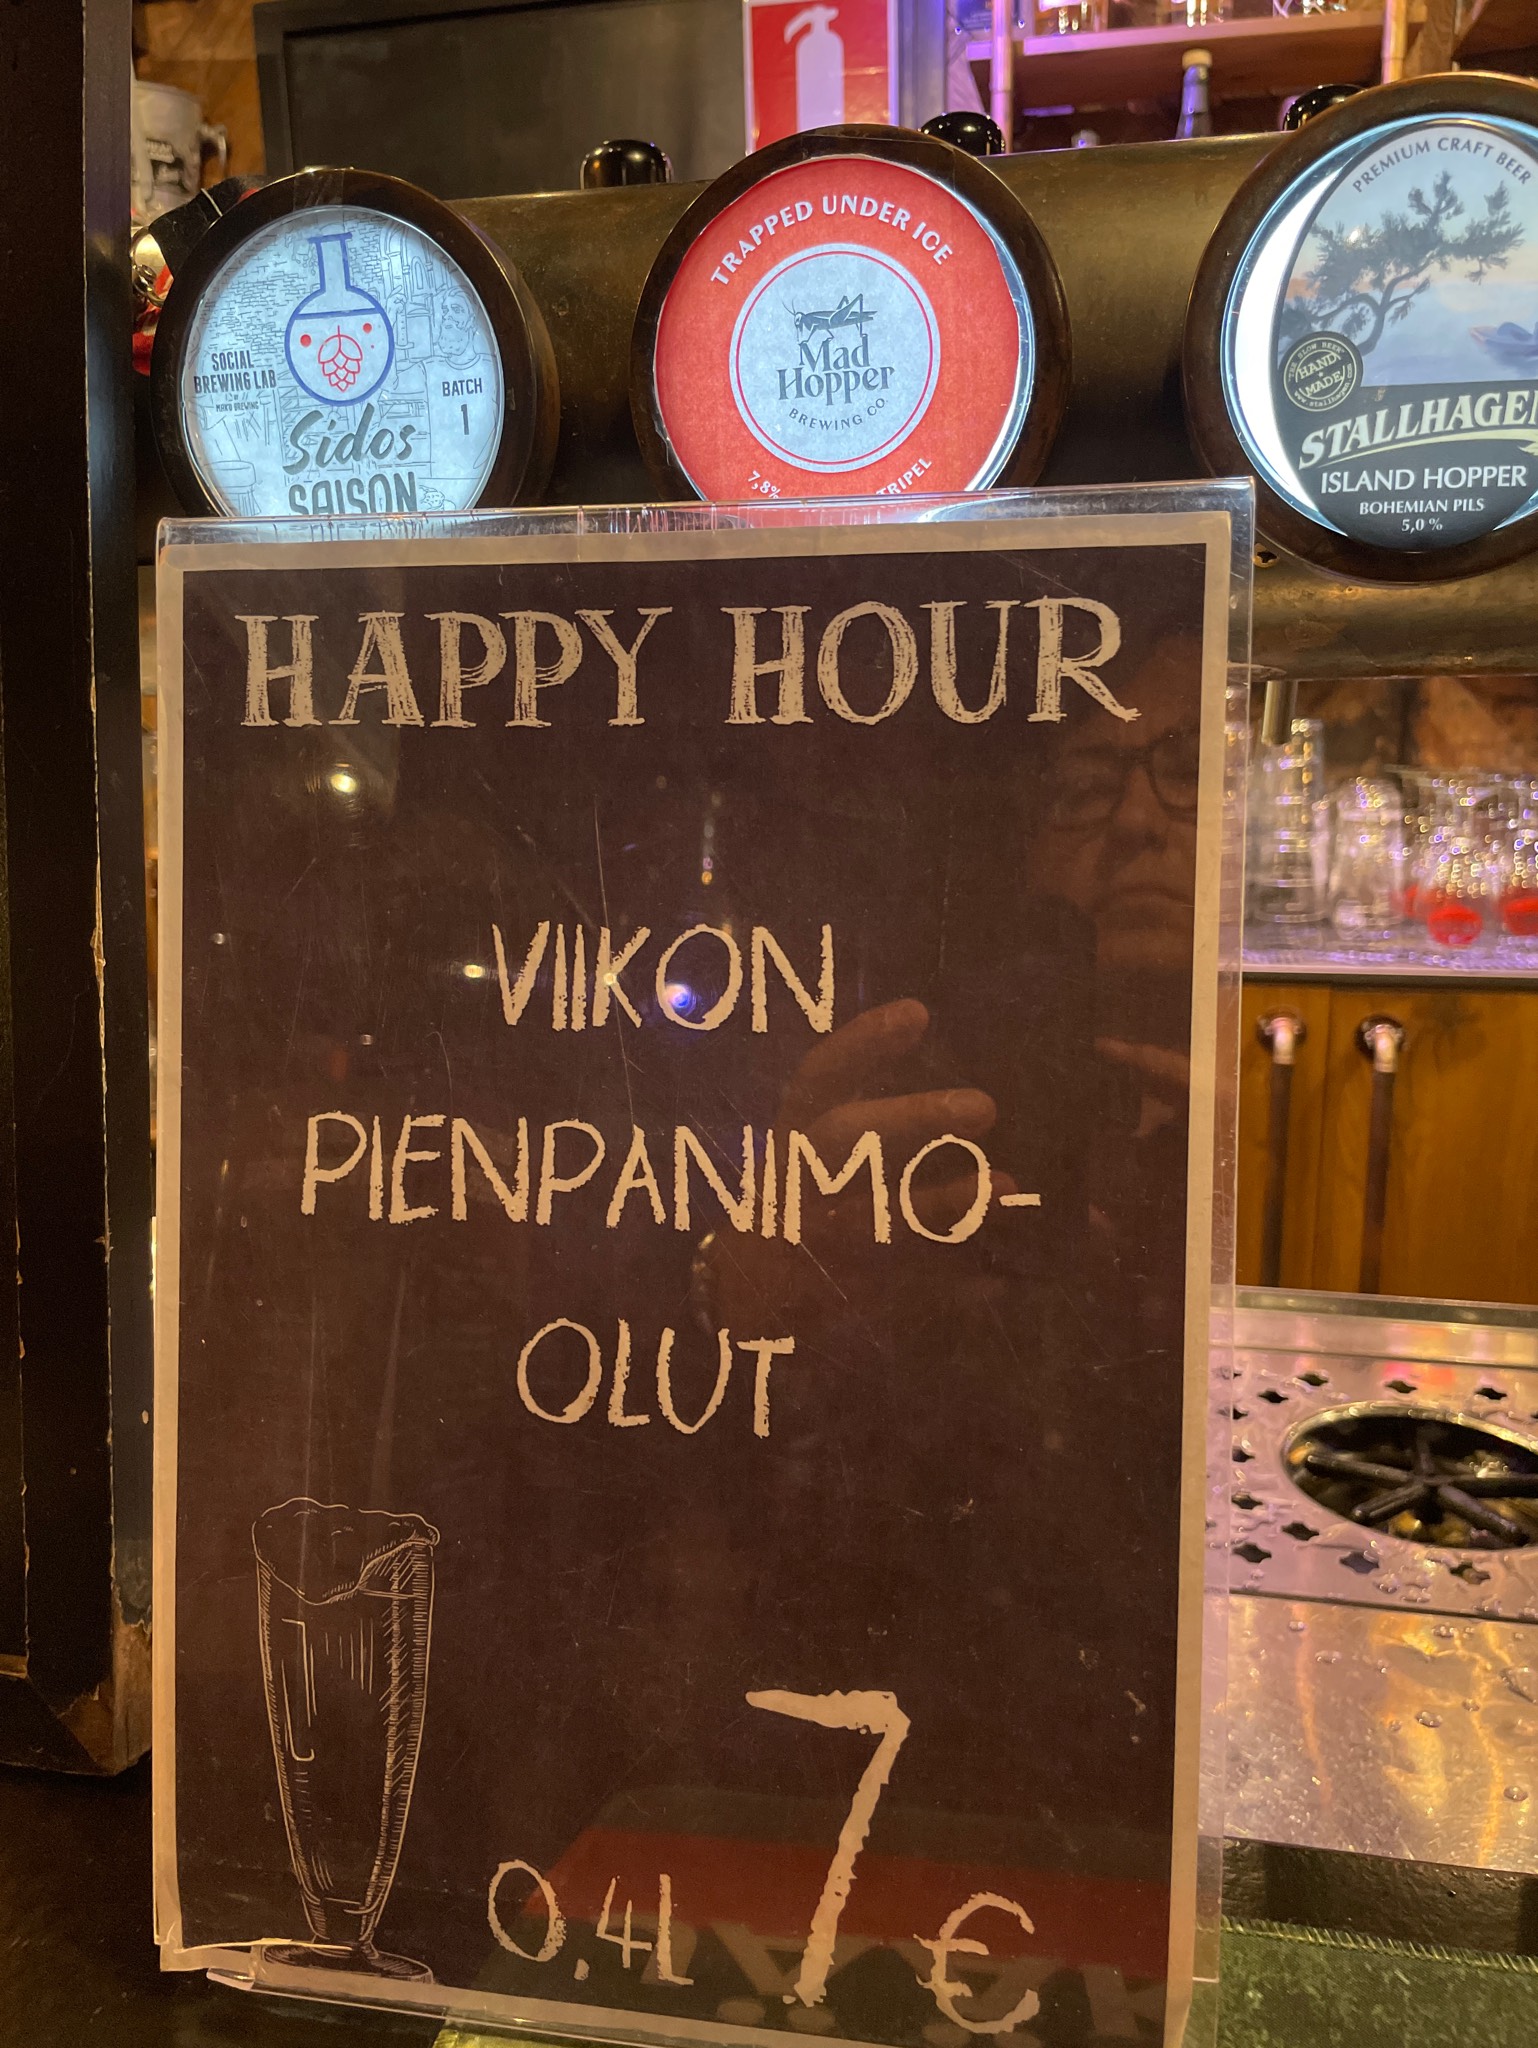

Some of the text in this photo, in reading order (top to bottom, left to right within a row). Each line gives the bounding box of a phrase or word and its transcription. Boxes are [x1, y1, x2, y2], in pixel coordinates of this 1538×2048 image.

[1353, 137, 1532, 193] PREMIUM CRAFT BEER
[710, 194, 953, 285] TRAPPED UNDER ICE
[211, 350, 254, 371] SOCIAL
[798, 333, 871, 372] Mad
[1297, 352, 1338, 380] HAND
[193, 369, 277, 394] BREWING LAB
[442, 377, 483, 397] BATCH
[776, 366, 896, 406] Hopper
[1305, 370, 1344, 398] MADE
[460, 404, 470, 435] 1
[788, 408, 863, 431] BREWING
[283, 402, 416, 475] Sidos
[288, 471, 418, 515] SAISON
[1321, 465, 1527, 494] ISLAND HOPPER
[1359, 498, 1484, 515] BOHEMIAN PILS
[1401, 517, 1443, 534] 5,0 %
[235, 595, 1142, 728] HAPPY HOUR
[491, 920, 834, 1034] VIIKON
[300, 1110, 1042, 1244] PIENPANIMO-
[515, 1317, 796, 1438] OLUT
